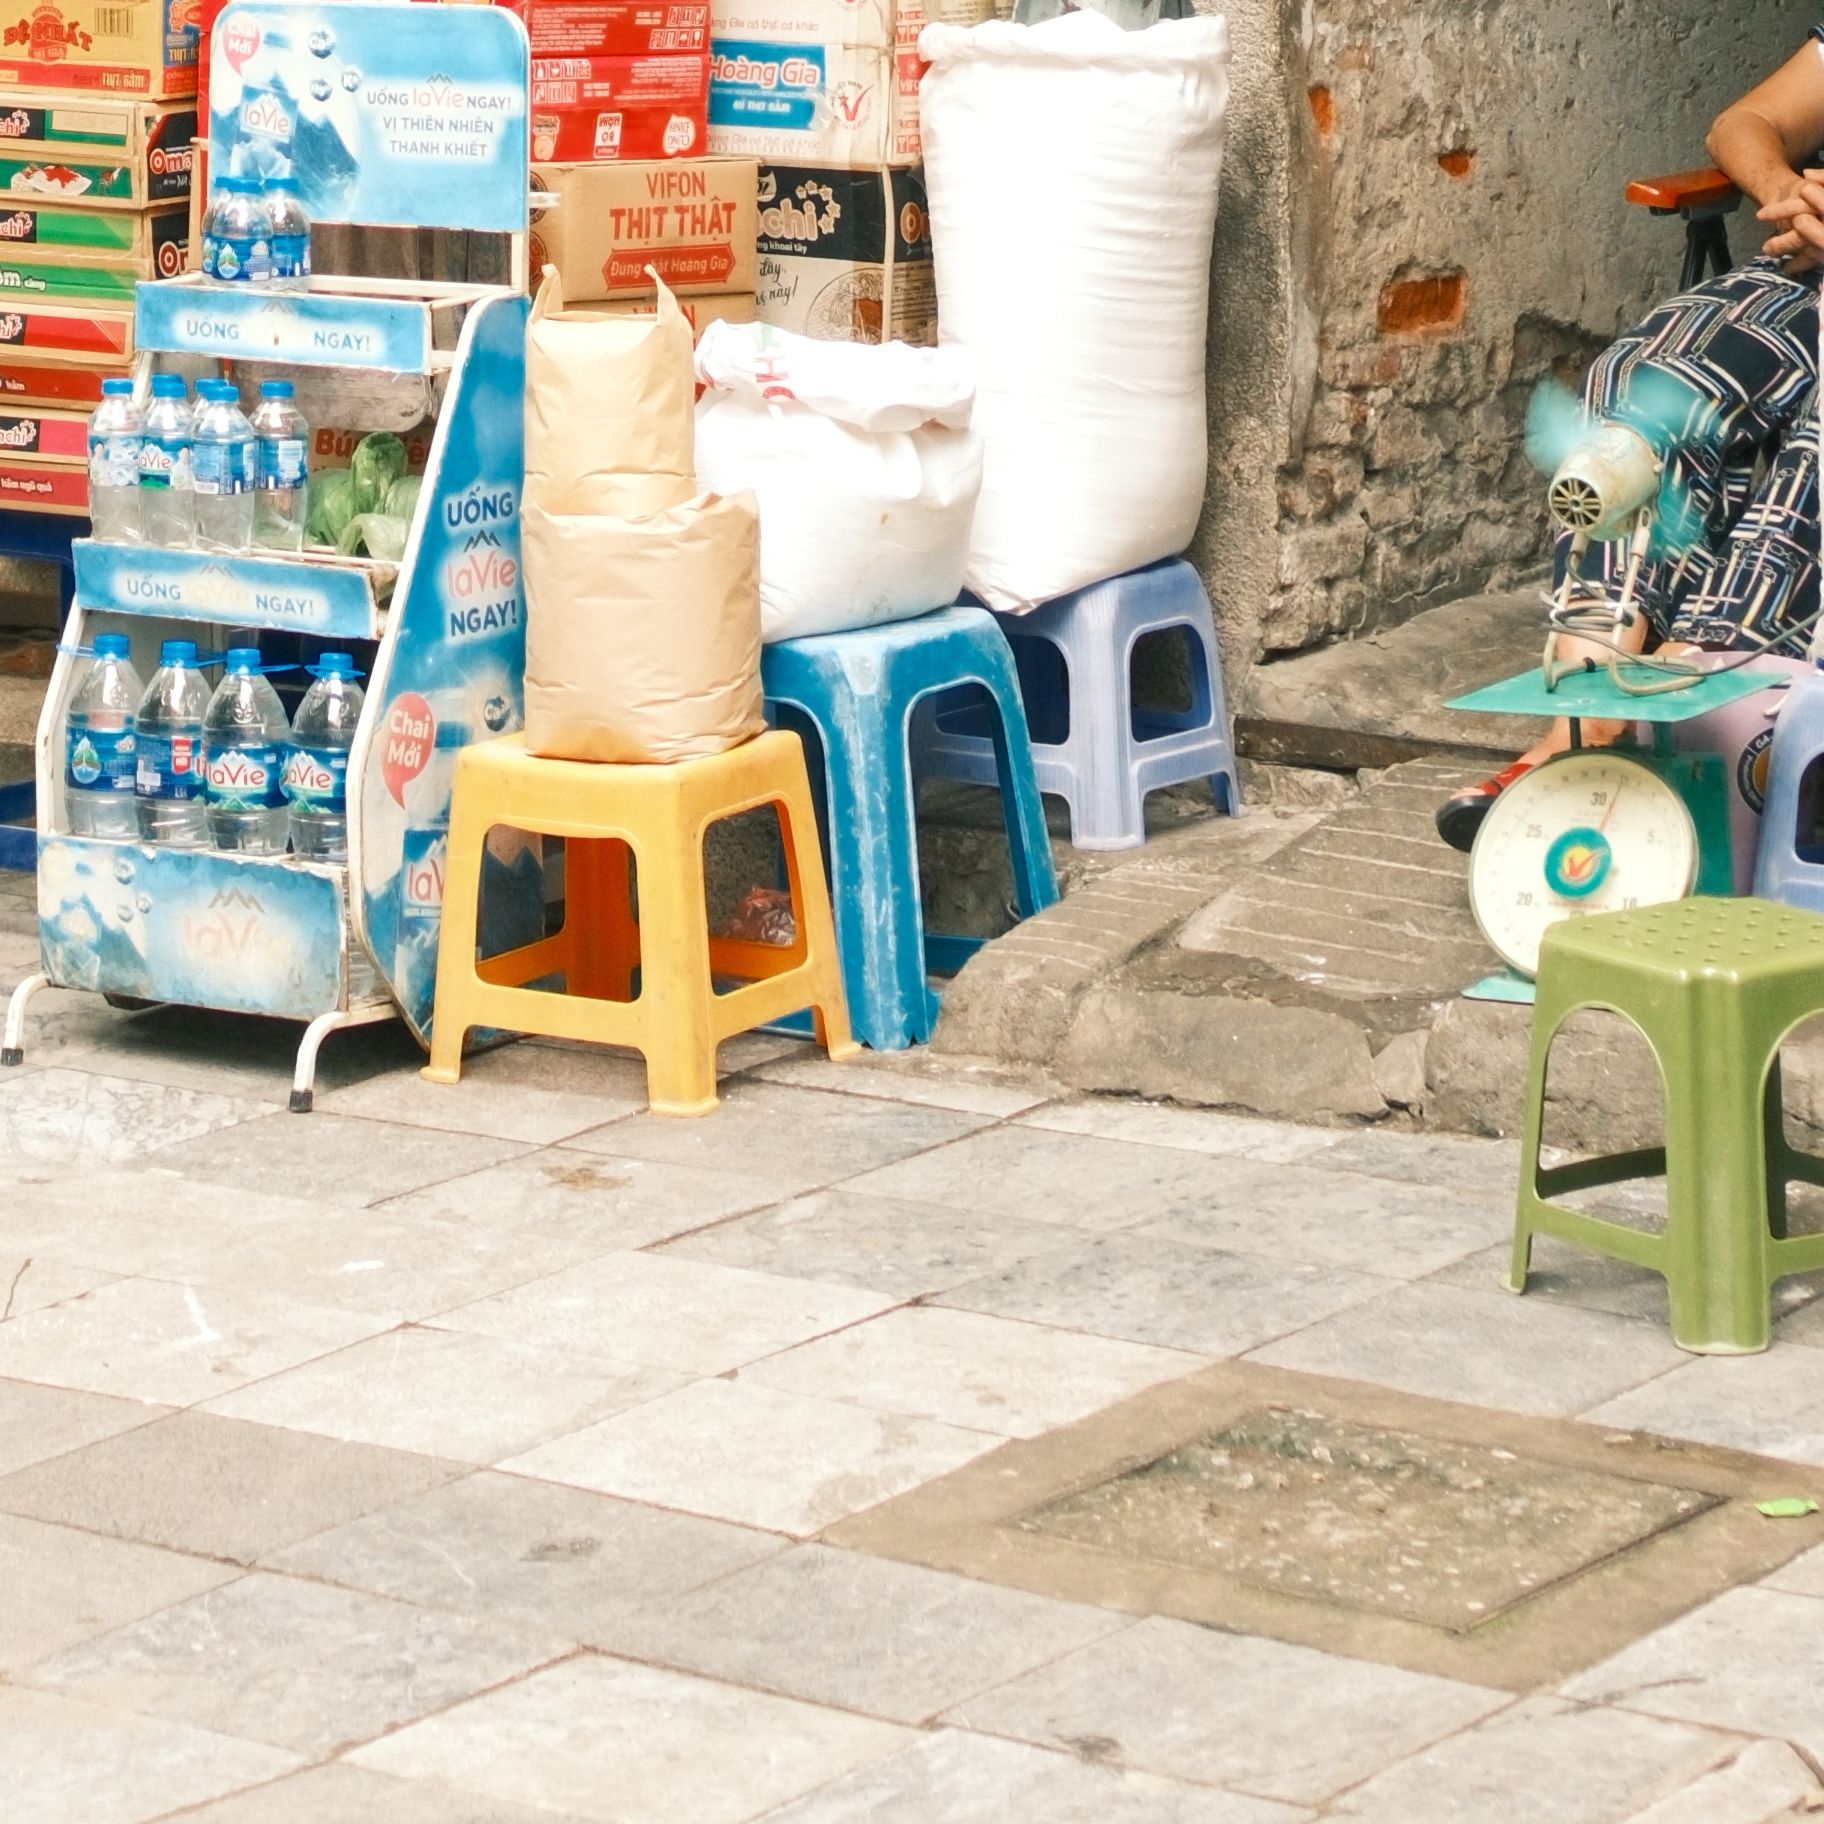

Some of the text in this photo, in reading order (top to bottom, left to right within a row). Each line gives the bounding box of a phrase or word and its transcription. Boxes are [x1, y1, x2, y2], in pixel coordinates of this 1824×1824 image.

[367, 81, 511, 110] UỐNG laVie NGAY!
[400, 114, 444, 132] THIÊN
[448, 114, 494, 133] NHIÊN
[390, 135, 487, 157] THANH KHIẾT
[447, 488, 514, 526] UỐNG
[447, 552, 517, 595] laVie
[450, 604, 517, 637] NGAY!
[389, 708, 428, 737] Chai
[388, 738, 423, 767] Mới
[208, 764, 265, 787] laVie
